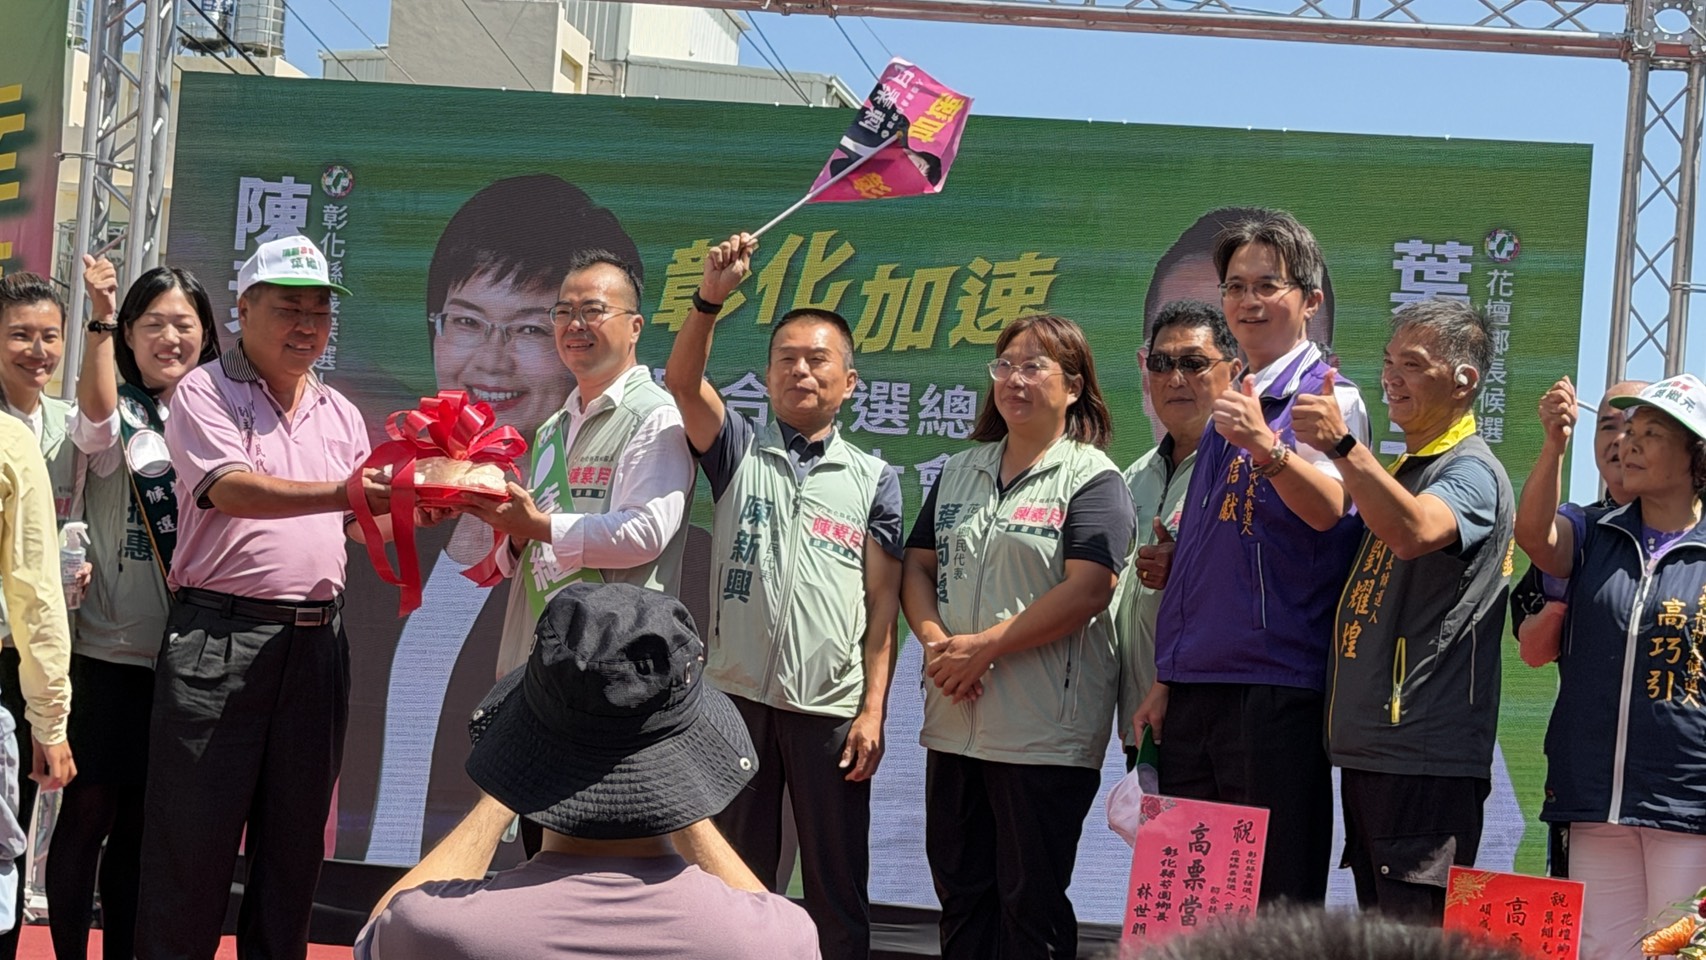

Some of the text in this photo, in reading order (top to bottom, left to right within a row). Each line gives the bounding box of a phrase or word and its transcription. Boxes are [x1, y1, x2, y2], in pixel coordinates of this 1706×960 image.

[723, 494, 775, 604] 陳新興
[1646, 598, 1688, 702] 高巧引
[1179, 822, 1212, 927] 高票當
[1232, 819, 1256, 844] 祝
